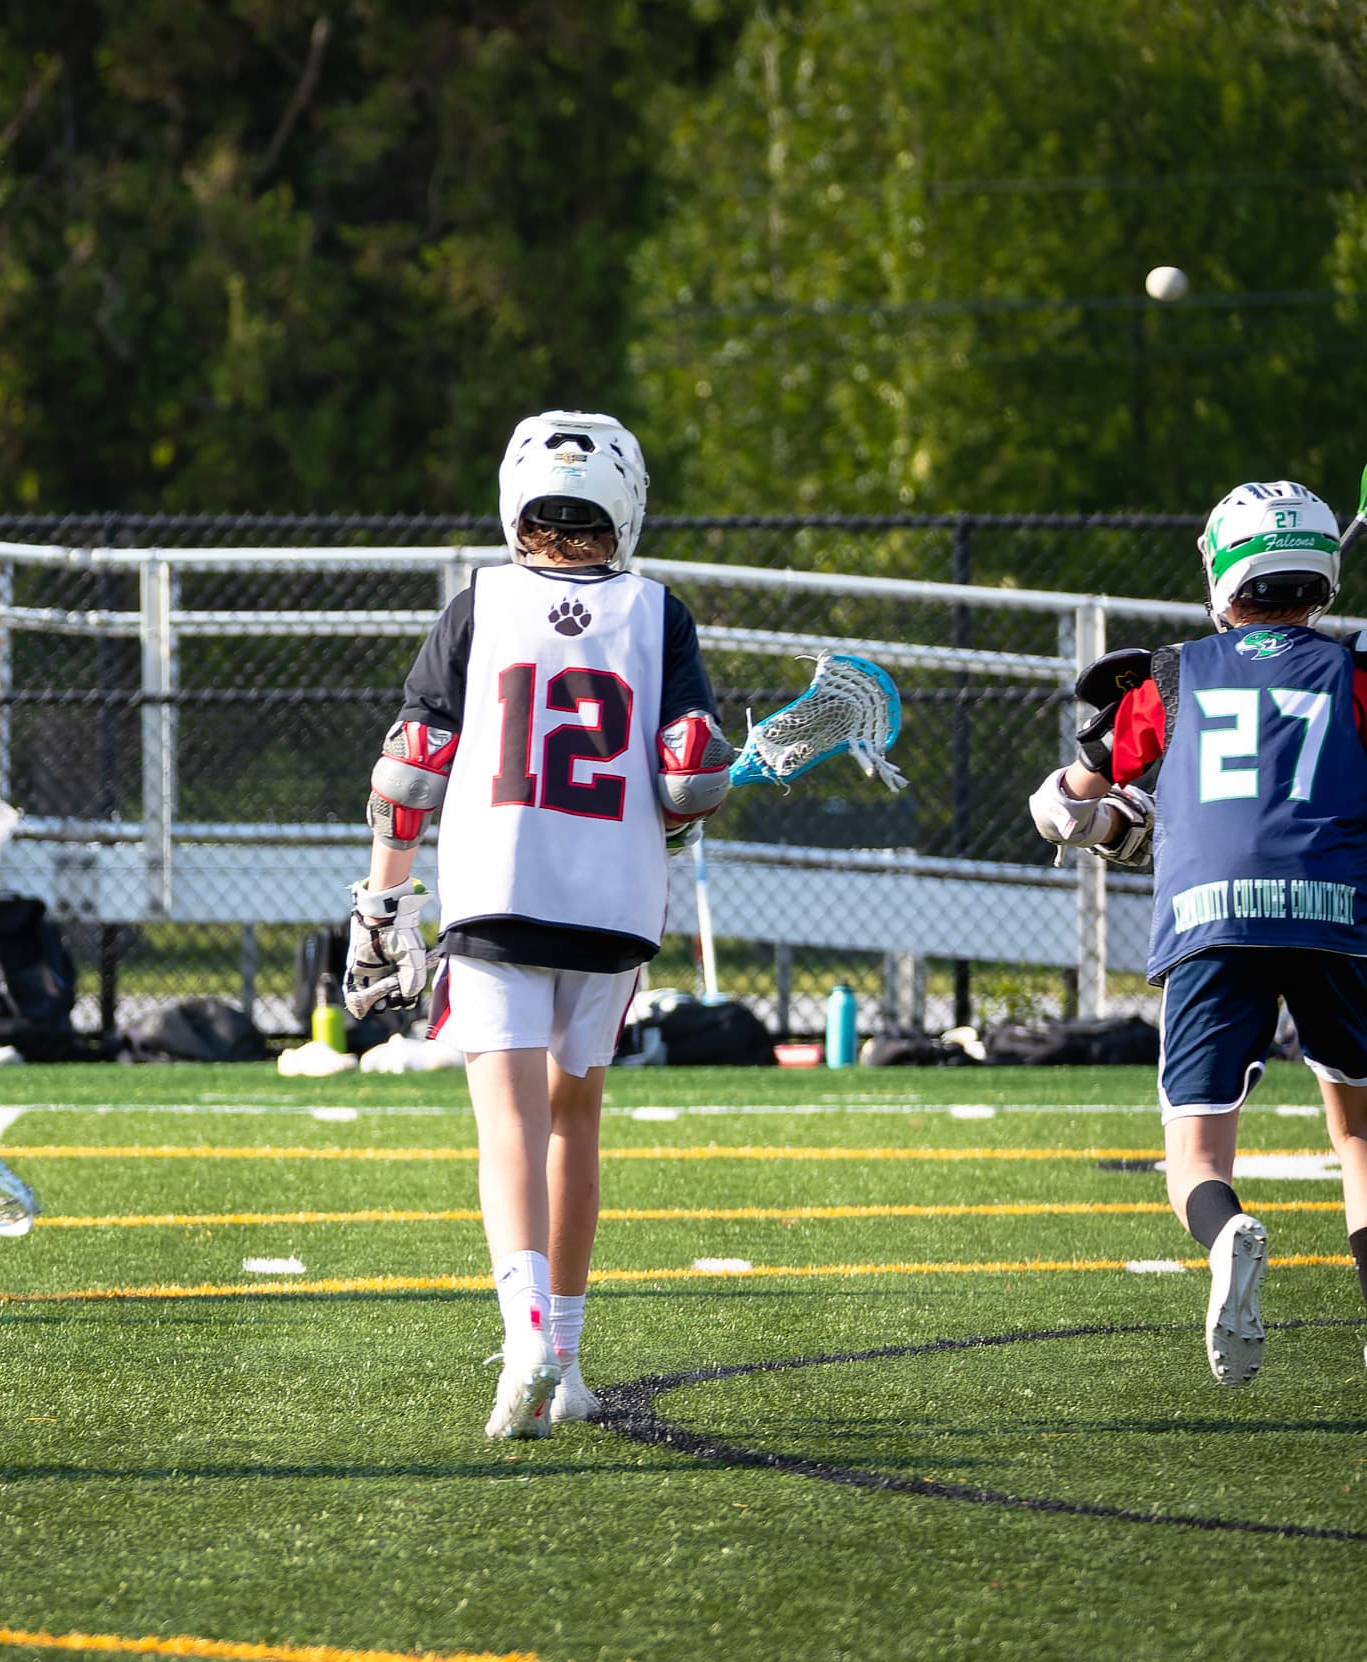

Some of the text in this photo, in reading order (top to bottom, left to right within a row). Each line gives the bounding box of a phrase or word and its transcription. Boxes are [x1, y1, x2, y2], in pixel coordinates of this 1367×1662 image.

[1263, 533, 1315, 551] Falcons
[1275, 510, 1297, 529] 27
[491, 663, 634, 822] 12
[1193, 688, 1333, 804] 27
[1233, 879, 1287, 918] CULTURE
[1290, 879, 1357, 926] COMMITMENT
